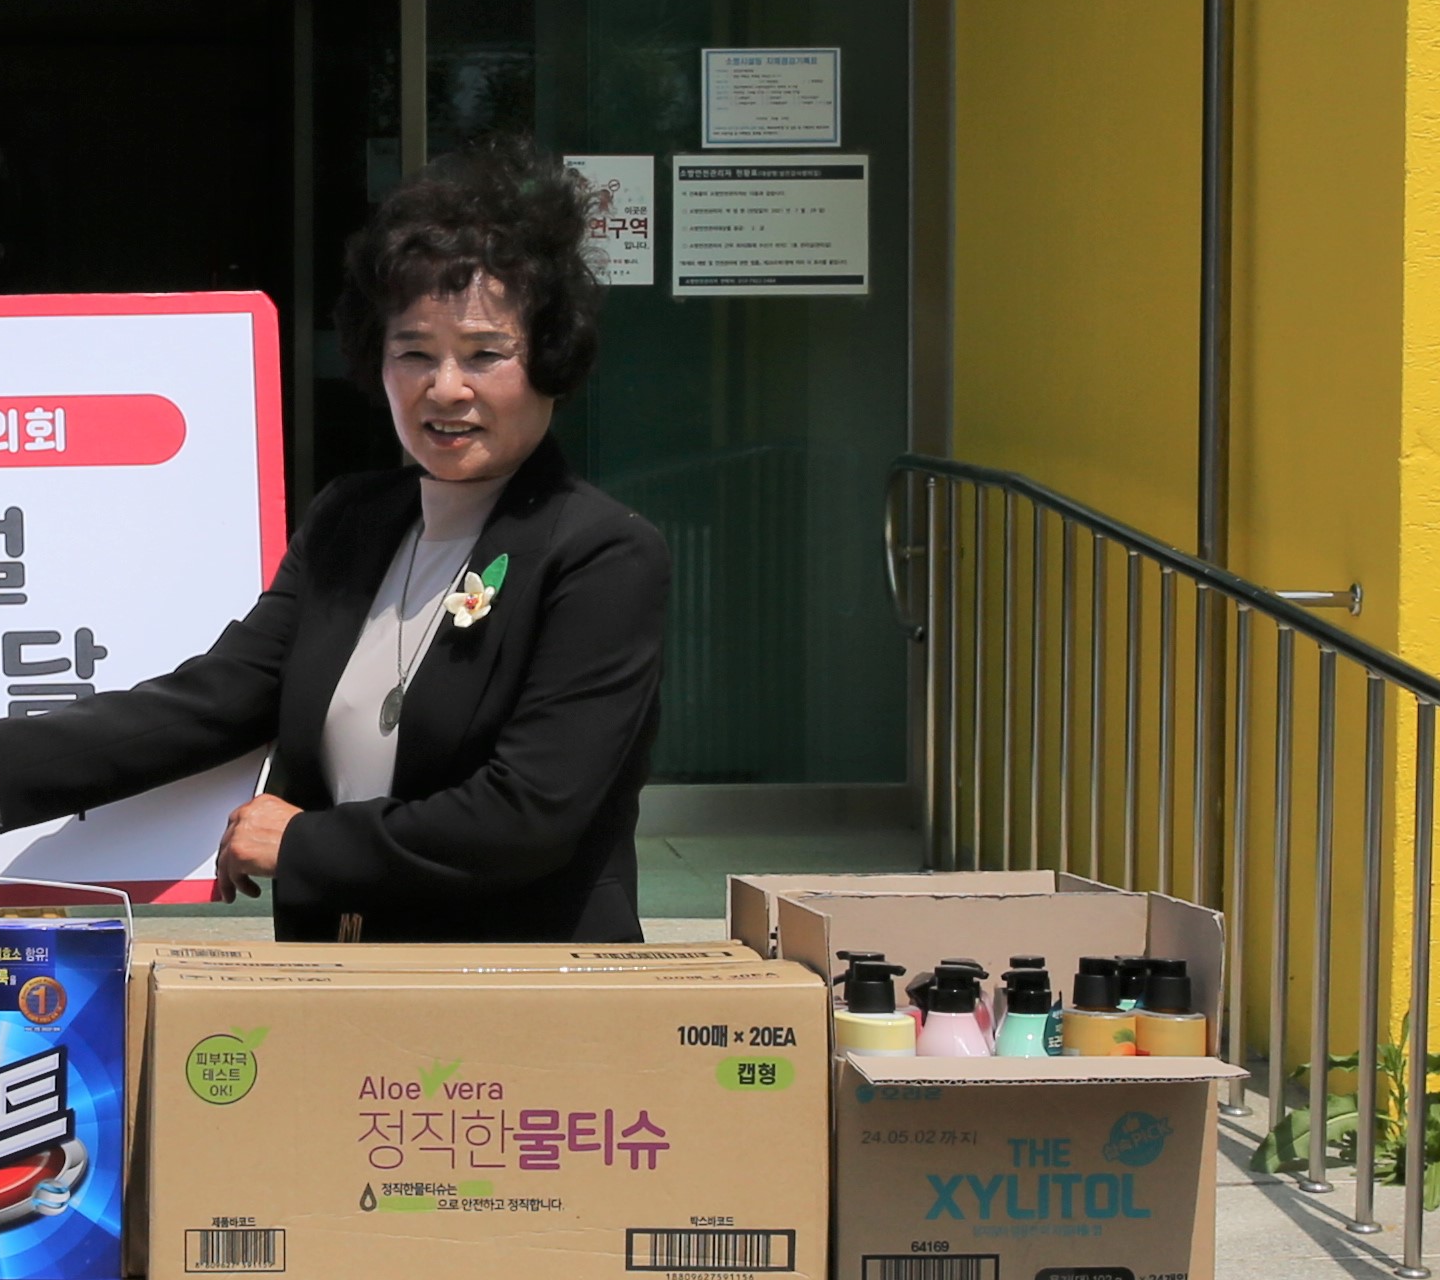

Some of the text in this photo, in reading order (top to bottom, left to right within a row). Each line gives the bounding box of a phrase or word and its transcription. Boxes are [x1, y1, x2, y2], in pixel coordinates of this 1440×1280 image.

[590, 217, 648, 239] 연구역
[25, 947, 49, 962] 함유!
[677, 1025, 797, 1048] 100매 20EA
[196, 1053, 247, 1066] 피부자극
[202, 1068, 240, 1081] 테스트
[736, 1061, 778, 1086] 캡형
[209, 1085, 232, 1097] OK!
[359, 1076, 504, 1100] Aloe vera
[357, 1108, 671, 1171] 정직한물티슈
[1008, 1138, 1070, 1168] THE
[381, 1182, 457, 1197] 정직한물티슈는
[925, 1174, 1151, 1220] XYLITOL
[437, 1197, 565, 1212] 으로 안전하고 정직합니다.
[211, 1217, 256, 1228] 제품바코드
[689, 1216, 734, 1228] 박스바코드
[911, 1241, 949, 1253] 64169
